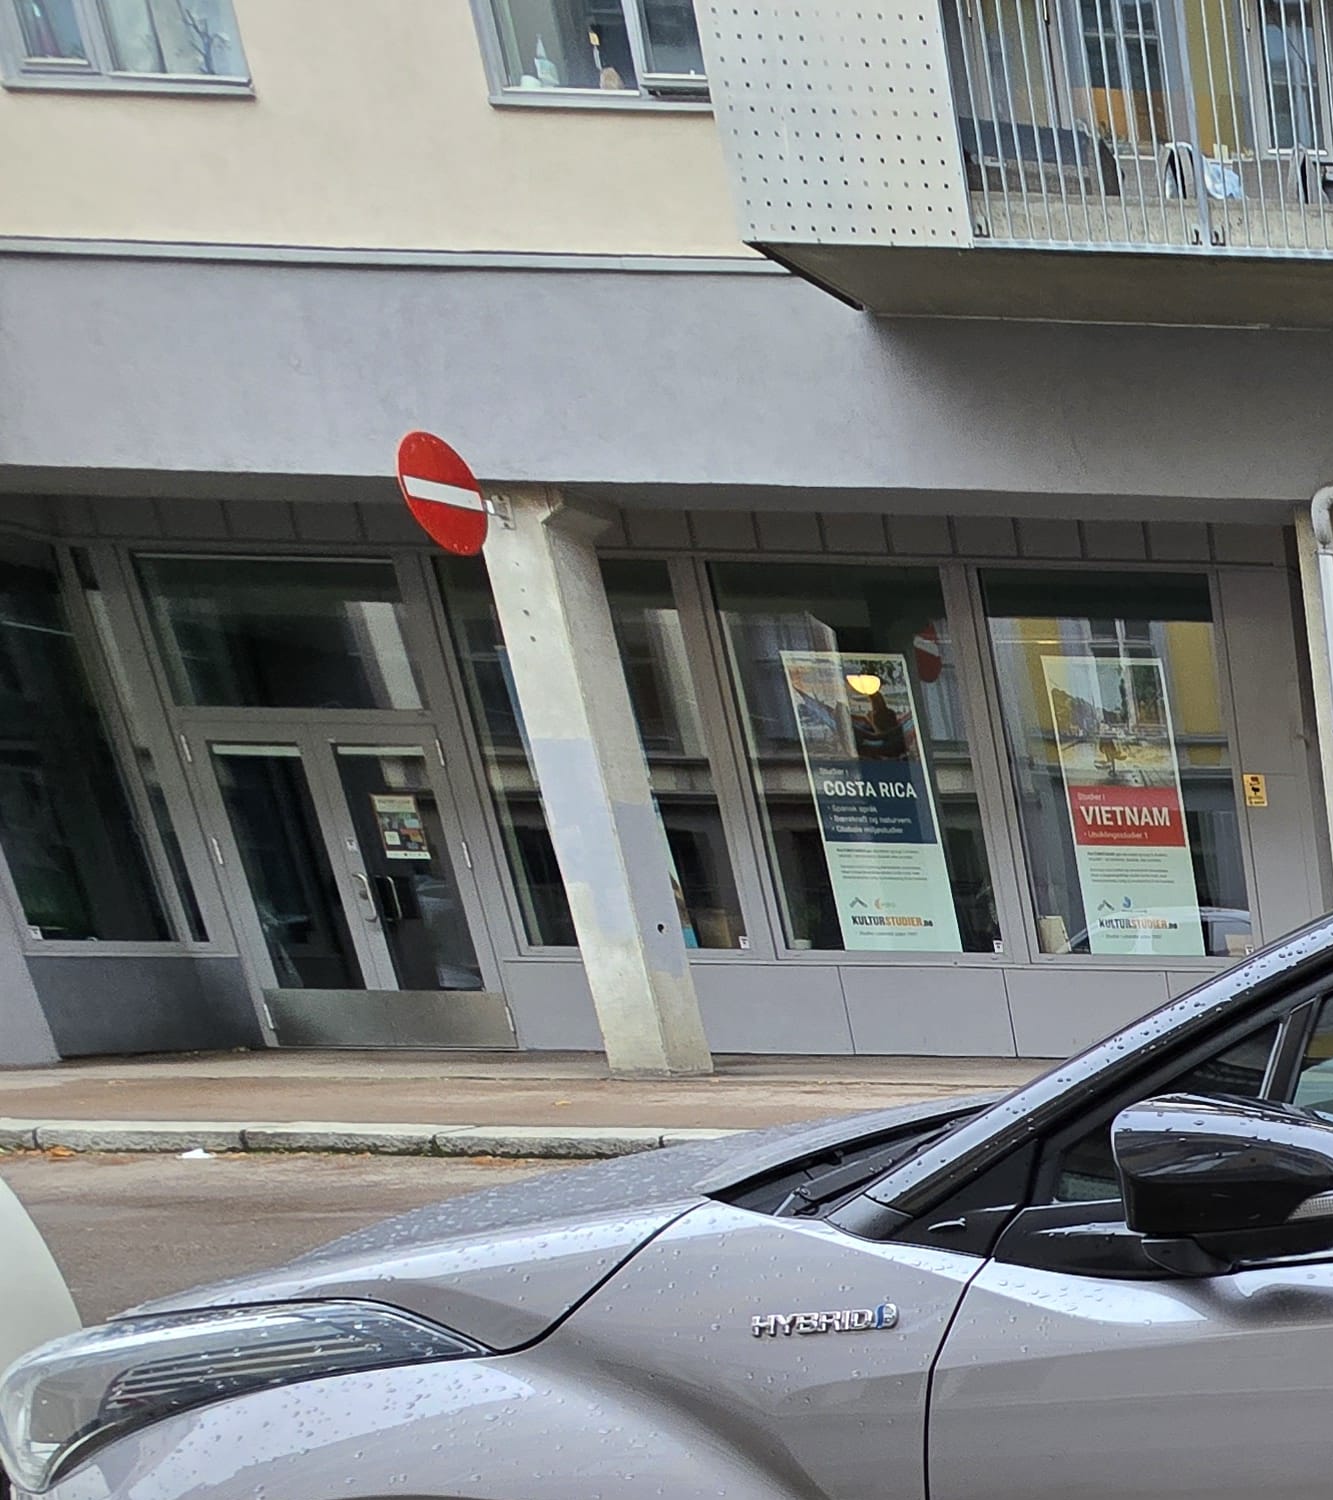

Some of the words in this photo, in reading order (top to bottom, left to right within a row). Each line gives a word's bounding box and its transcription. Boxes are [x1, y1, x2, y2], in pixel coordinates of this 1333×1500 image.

[823, 780, 877, 798] COSTA
[879, 781, 918, 799] RICA
[1080, 805, 1171, 827] VIETNAM
[751, 1308, 874, 1338] HYBRID
